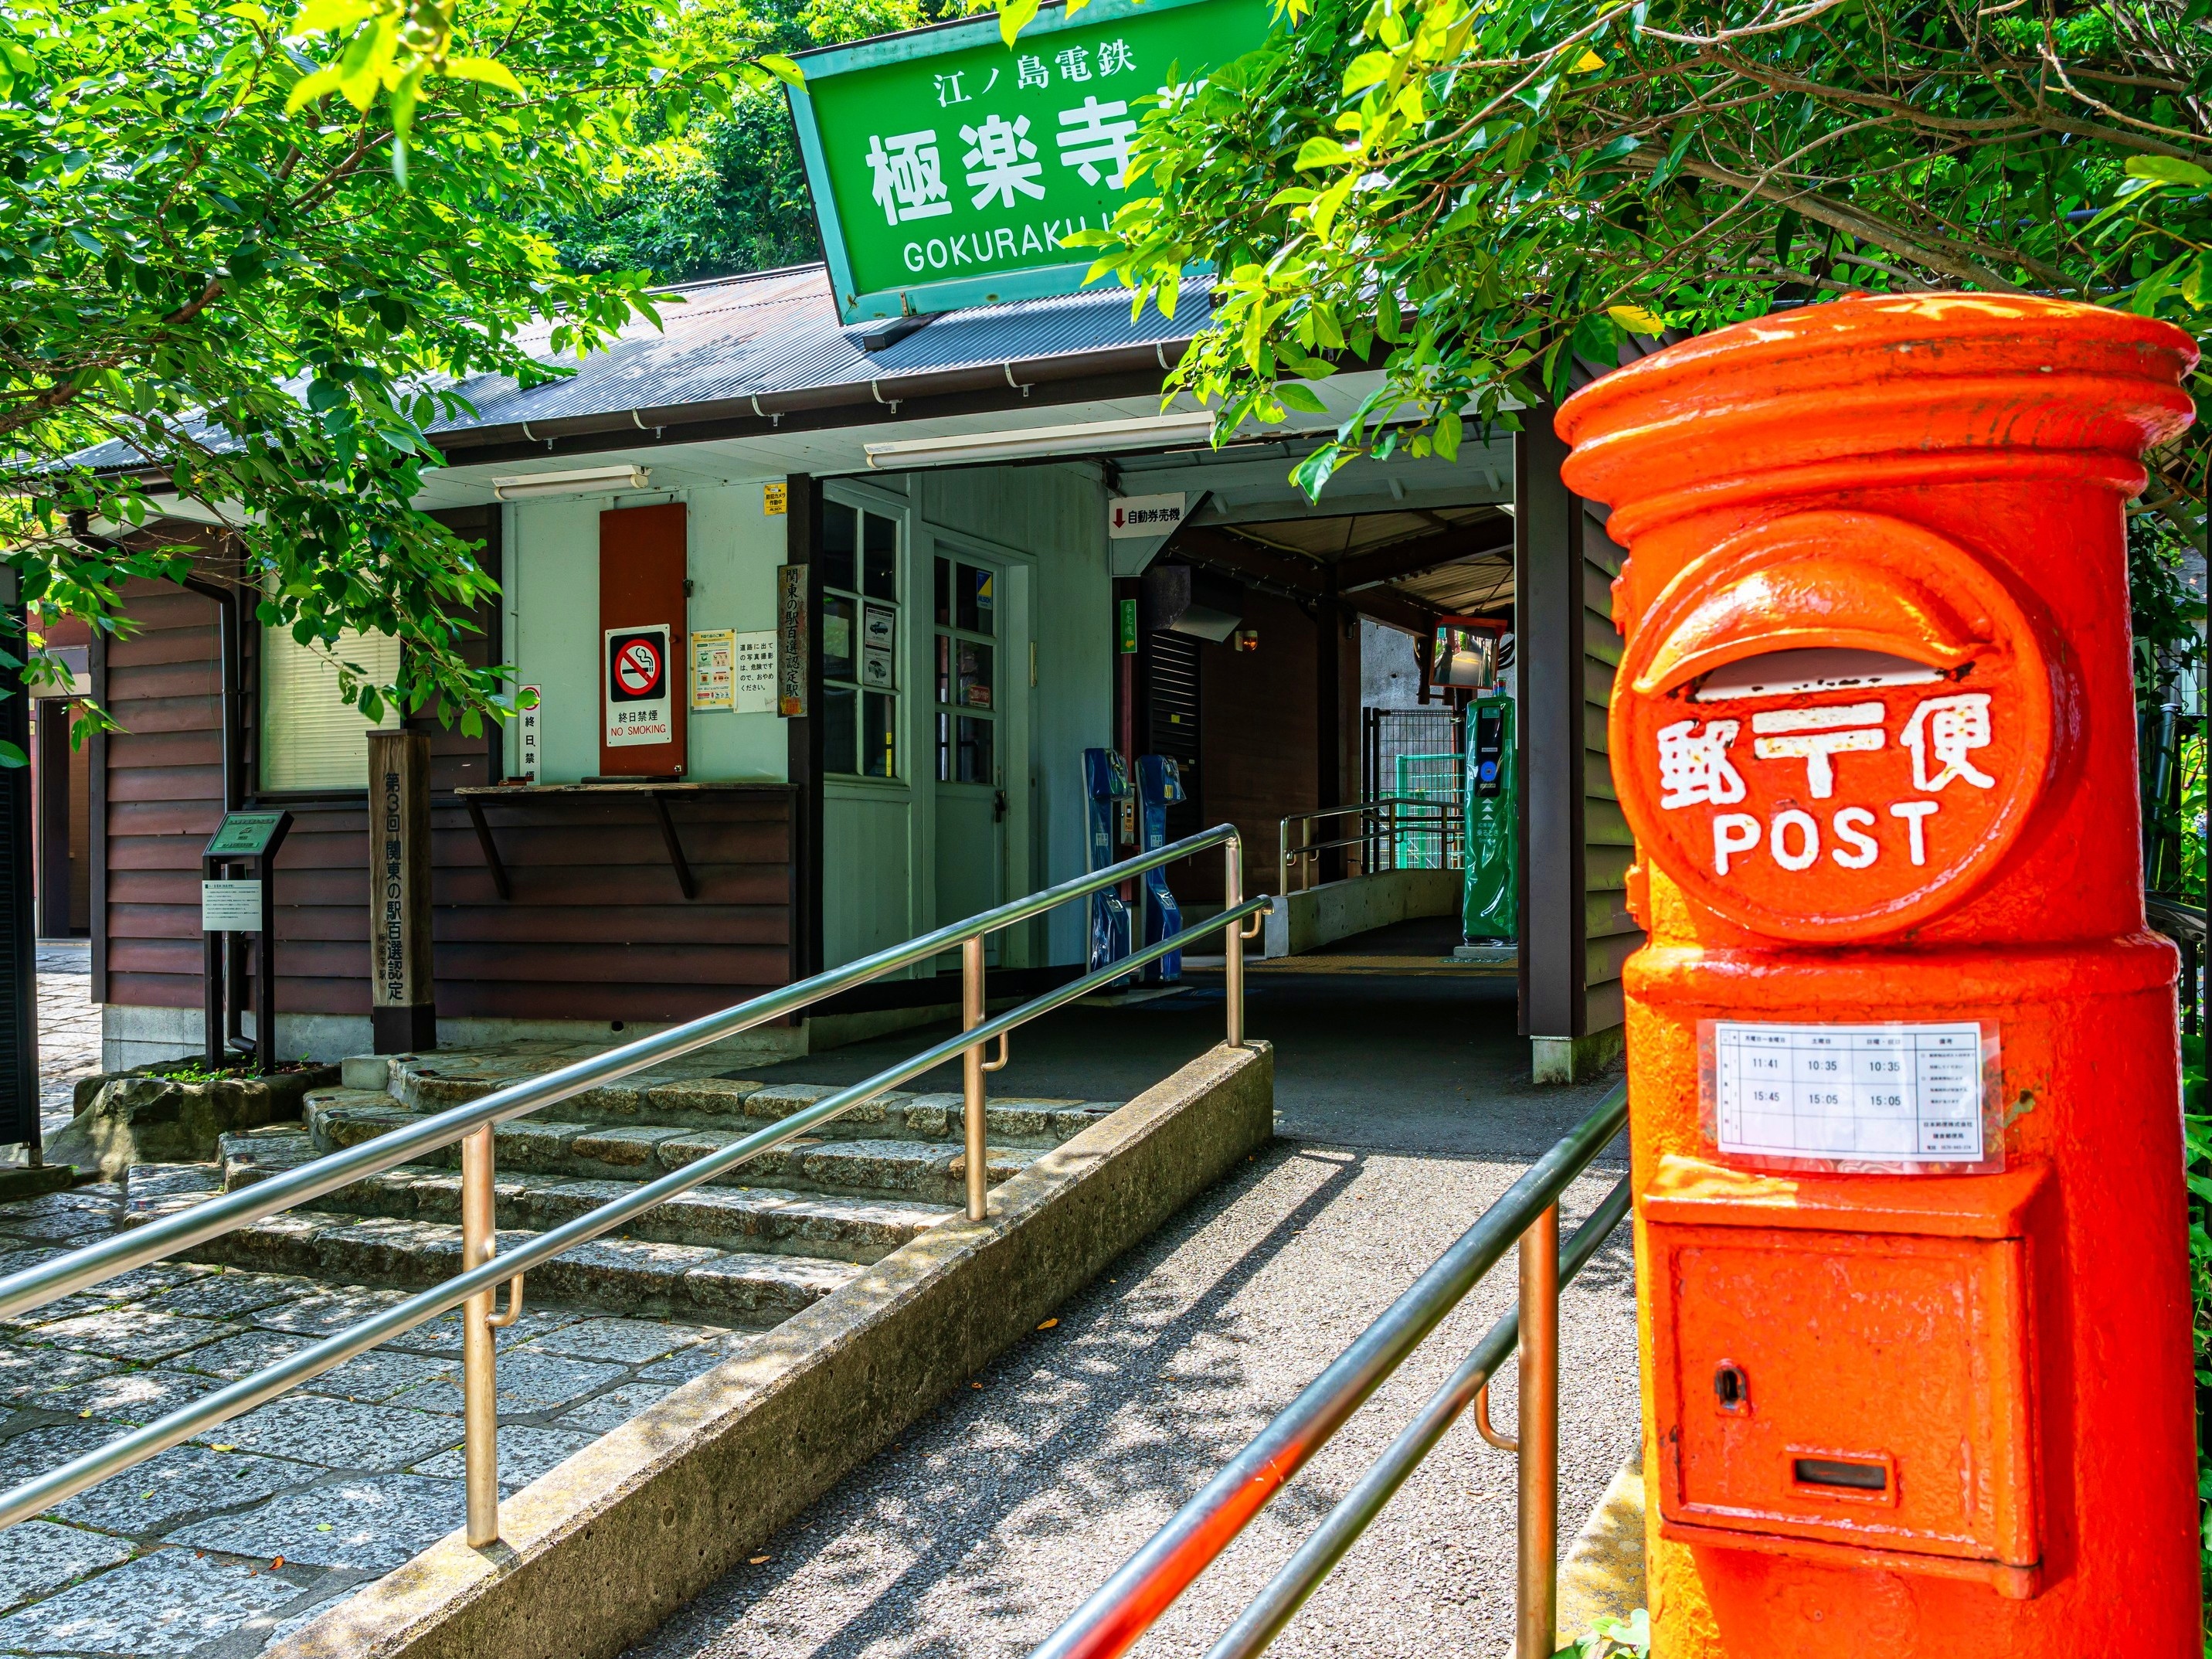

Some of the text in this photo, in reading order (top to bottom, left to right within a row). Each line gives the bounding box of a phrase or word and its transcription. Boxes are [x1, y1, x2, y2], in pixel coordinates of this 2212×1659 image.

[933, 39, 1137, 108] 江ノ島電鉄
[865, 79, 1210, 226] 極楽寺
[1128, 507, 1181, 525] 自動券売機
[1124, 603, 1134, 636] 券売機
[785, 568, 800, 698] 関東の駅百選認定駅
[739, 642, 774, 651] 道路に出て
[739, 652, 774, 661] の写真撮影
[739, 662, 774, 671] は、危険です
[739, 673, 774, 682] ので、おやめ
[618, 709, 658, 723] 終日禁煙
[610, 723, 667, 736] NO SMOKING
[1712, 801, 1939, 876] POST
[385, 772, 403, 1001] 第3回 関東の駅百選認定
[377, 933, 386, 981] 極楽寺駅
[1752, 1058, 1778, 1069] 11:41
[1808, 1060, 1837, 1071] 10:35
[1869, 1061, 1901, 1072] 10:35
[1754, 1091, 1780, 1102] 15:45
[1809, 1094, 1839, 1105] 15:05
[1871, 1096, 1901, 1106] 15:05
